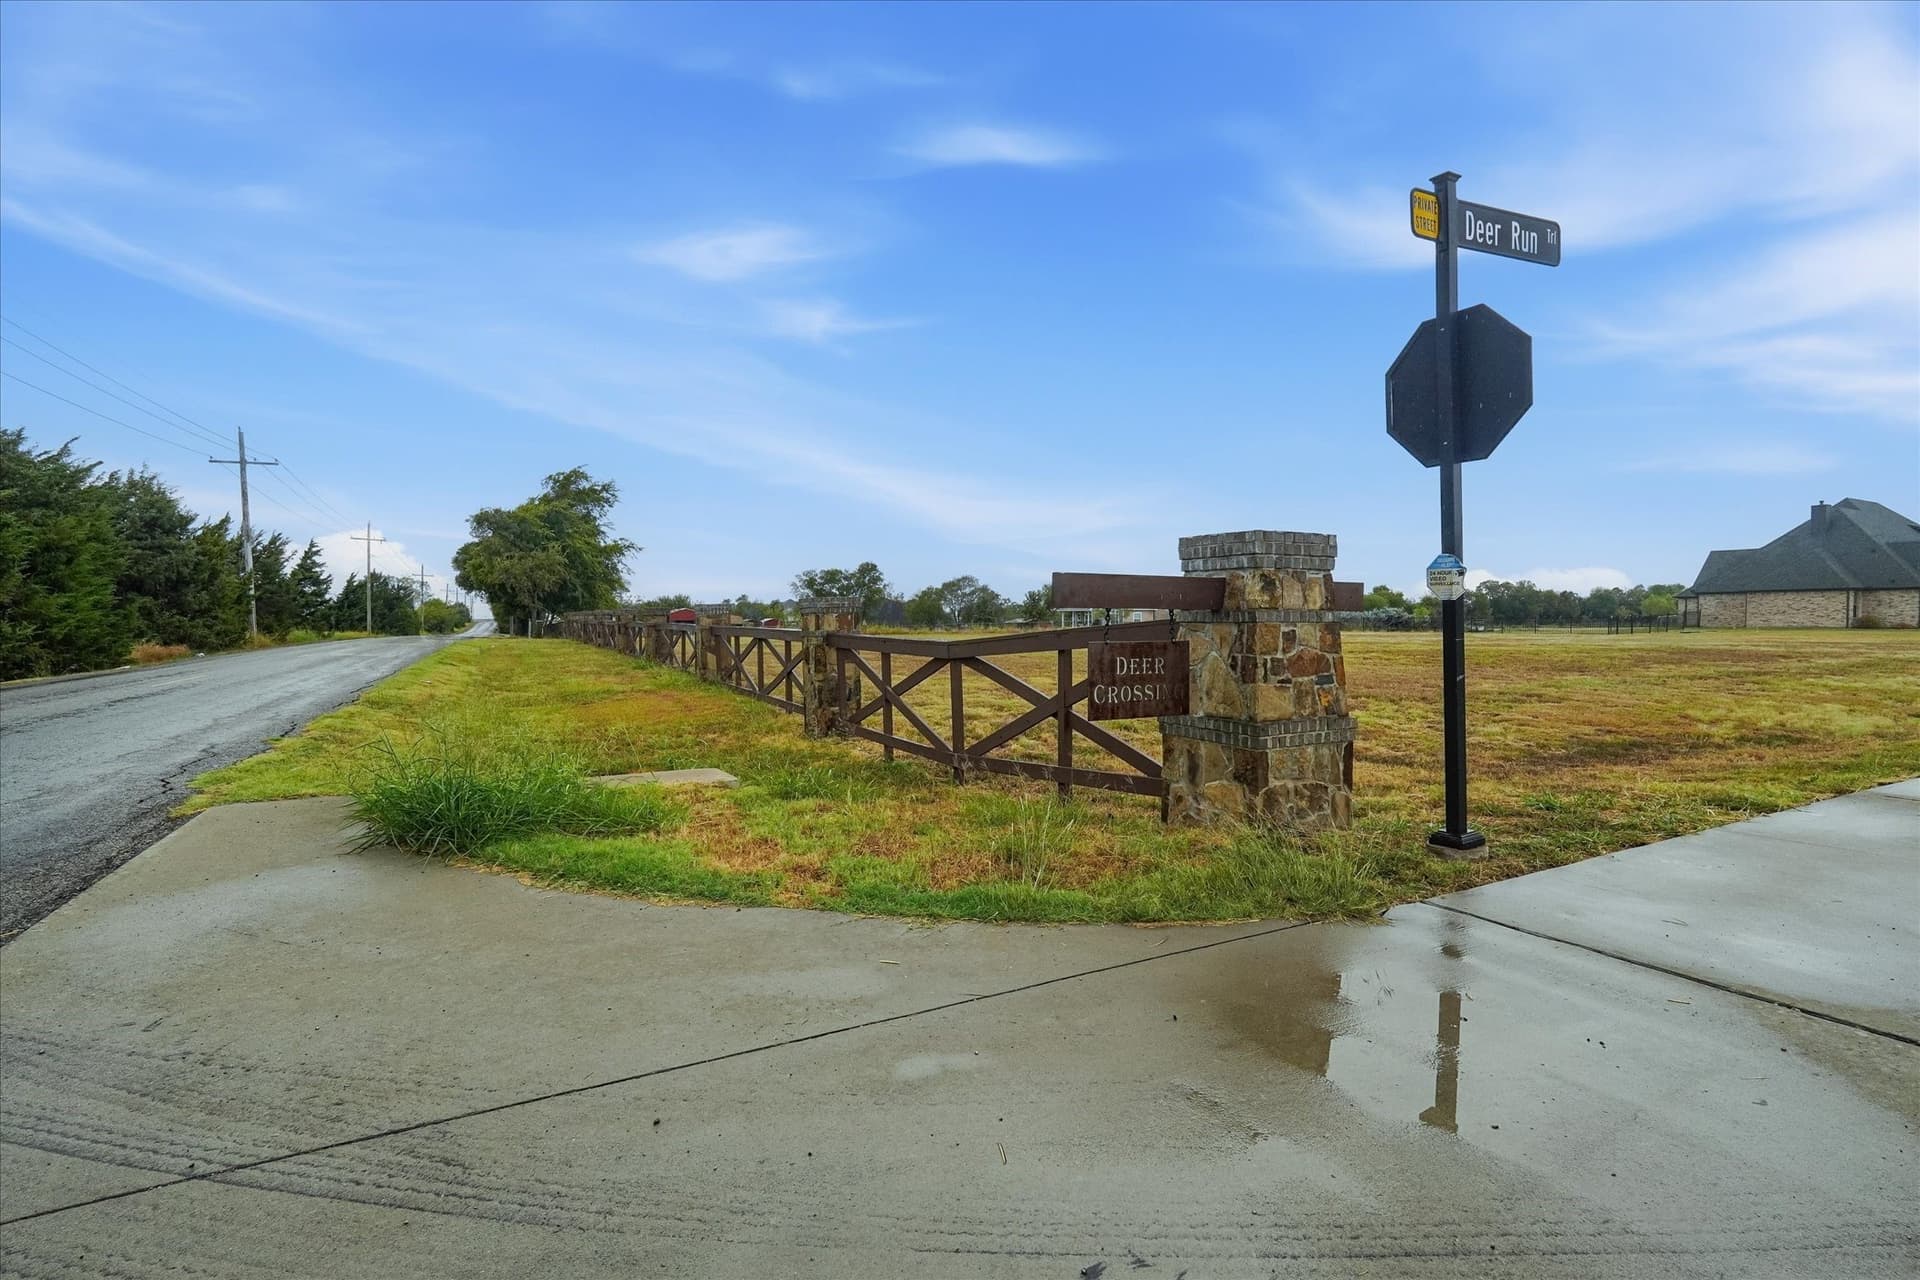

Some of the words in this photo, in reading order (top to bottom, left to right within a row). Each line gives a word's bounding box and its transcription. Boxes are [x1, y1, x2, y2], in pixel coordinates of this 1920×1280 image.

[1413, 195, 1438, 216] PRIVATE
[1415, 215, 1437, 233] STREET
[1465, 210, 1501, 246] Deer
[1511, 221, 1538, 255] Run
[1547, 228, 1557, 245] Trl
[1116, 656, 1165, 675] DEER
